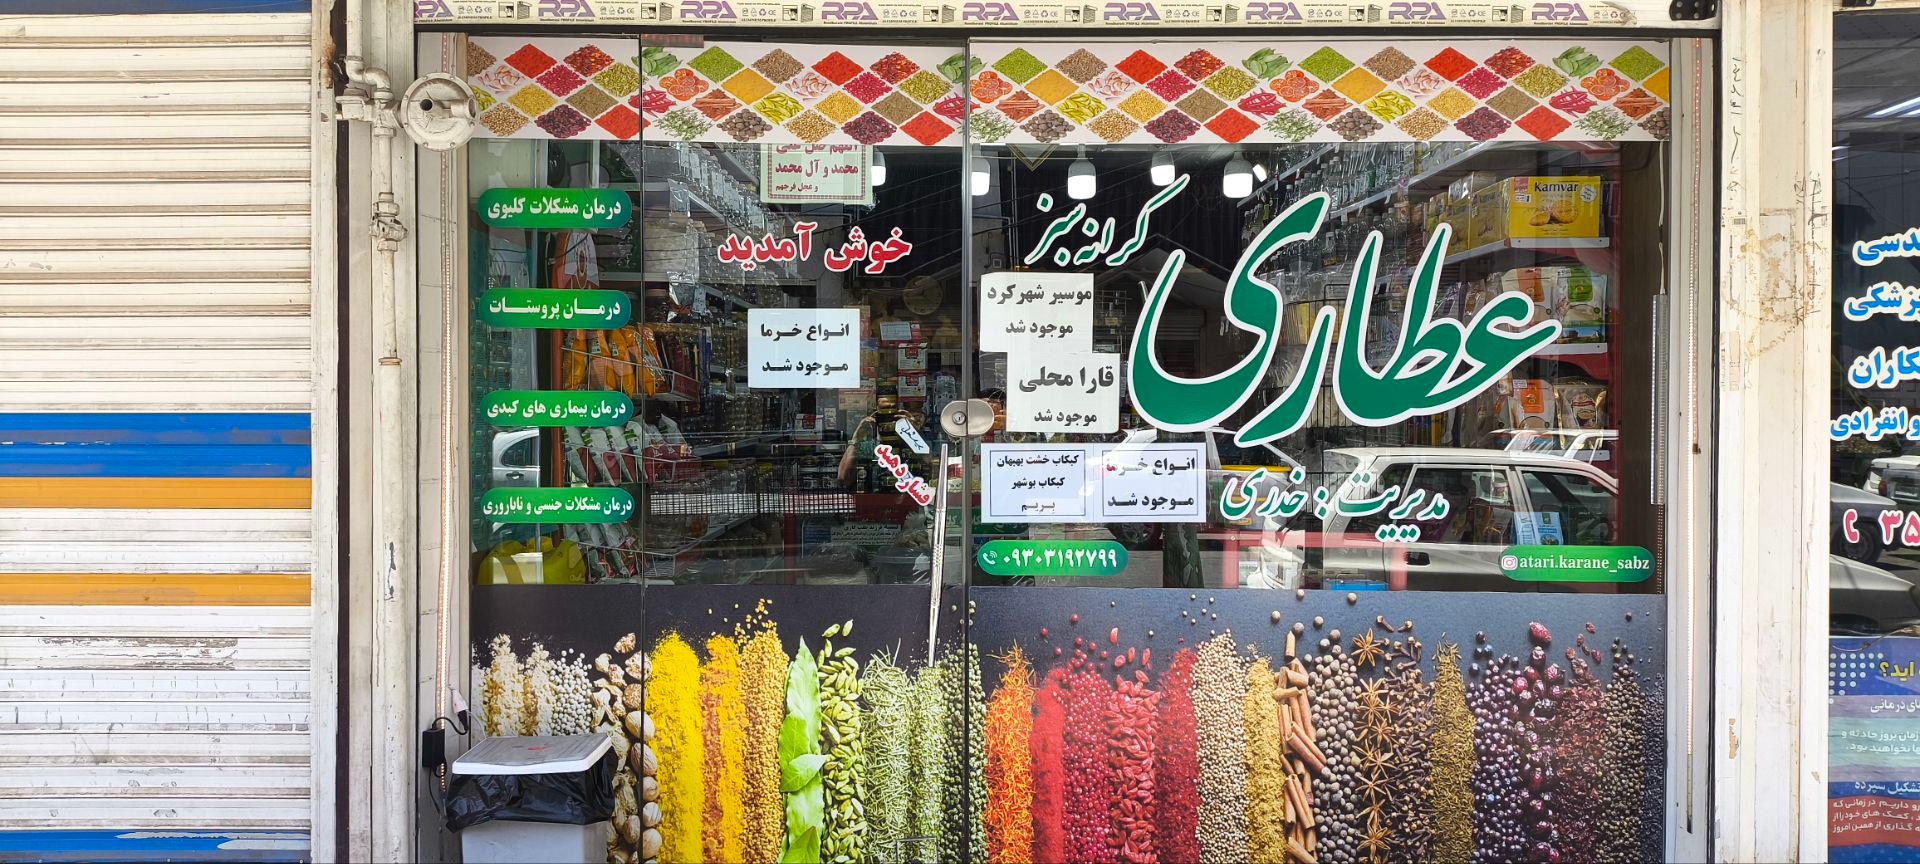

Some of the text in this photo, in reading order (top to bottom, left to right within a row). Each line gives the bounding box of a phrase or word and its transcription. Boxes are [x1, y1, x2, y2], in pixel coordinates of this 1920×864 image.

[414, 0, 454, 18] PA
[538, 0, 596, 17] RPA
[681, 0, 738, 19] RPA
[821, 1, 879, 21] RPA
[962, 2, 1020, 21] RPA
[1103, 2, 1161, 21] RPA
[1245, 2, 1303, 20] RPA
[1388, 2, 1447, 20] RPA
[1531, 2, 1589, 21] RPA
[775, 159, 859, 178] محمد و آل محمد
[797, 182, 813, 192] عجل
[1534, 181, 1579, 193] Kamvar
[487, 196, 622, 220] درمان مشکلات کلیوی
[1023, 173, 1191, 268] کرانه سبز
[718, 221, 912, 274] خوش آمدید
[1853, 228, 1920, 266] دسی
[1049, 289, 1092, 305] موسیر
[1844, 281, 1920, 321] زشکی
[489, 296, 621, 320] درمان پروستات
[1128, 191, 1562, 447] عطاری
[761, 323, 849, 341] انواع خرما
[1005, 319, 1074, 338] موجود شد
[762, 358, 849, 375] موجود شد
[1848, 346, 1920, 388] کاران
[1018, 366, 1114, 394] قارا محلی
[487, 399, 626, 419] درمان بیماری های کبدی
[1034, 408, 1098, 427] موجود شد
[1830, 406, 1908, 441] انفرادی
[996, 454, 1079, 468] کبکاب خشت بهبهان
[1152, 457, 1195, 475] انواع
[874, 444, 936, 506] فشار دهید
[1011, 477, 1066, 490] کبکاب بوشهر
[483, 495, 632, 516] درمان مشکلات جنسی و ناباروری
[1107, 493, 1195, 511] موجود شد
[1334, 469, 1450, 543] مدیریت
[1003, 547, 1117, 568] ۰۹۳۰۳۱۹۲۷۹۹
[1519, 555, 1650, 573] atari.karane_sabz
[1870, 698, 1906, 713] درمانی
[1850, 729, 1877, 738] حادثه
[1880, 732, 1899, 742] بروز
[1899, 730, 1919, 741] زمان
[1869, 744, 1911, 755] نخواهید
[1854, 781, 1886, 793] سپرده
[1833, 800, 1844, 808] که
[1845, 798, 1866, 808] زمانی
[1867, 799, 1876, 807] در
[1879, 800, 1909, 810] داریم
[1862, 810, 1880, 820] های
[1832, 823, 1850, 834] امروز
[1852, 821, 1873, 831] همین
[1874, 821, 1882, 829] از
[1883, 822, 1913, 831] گذاری
